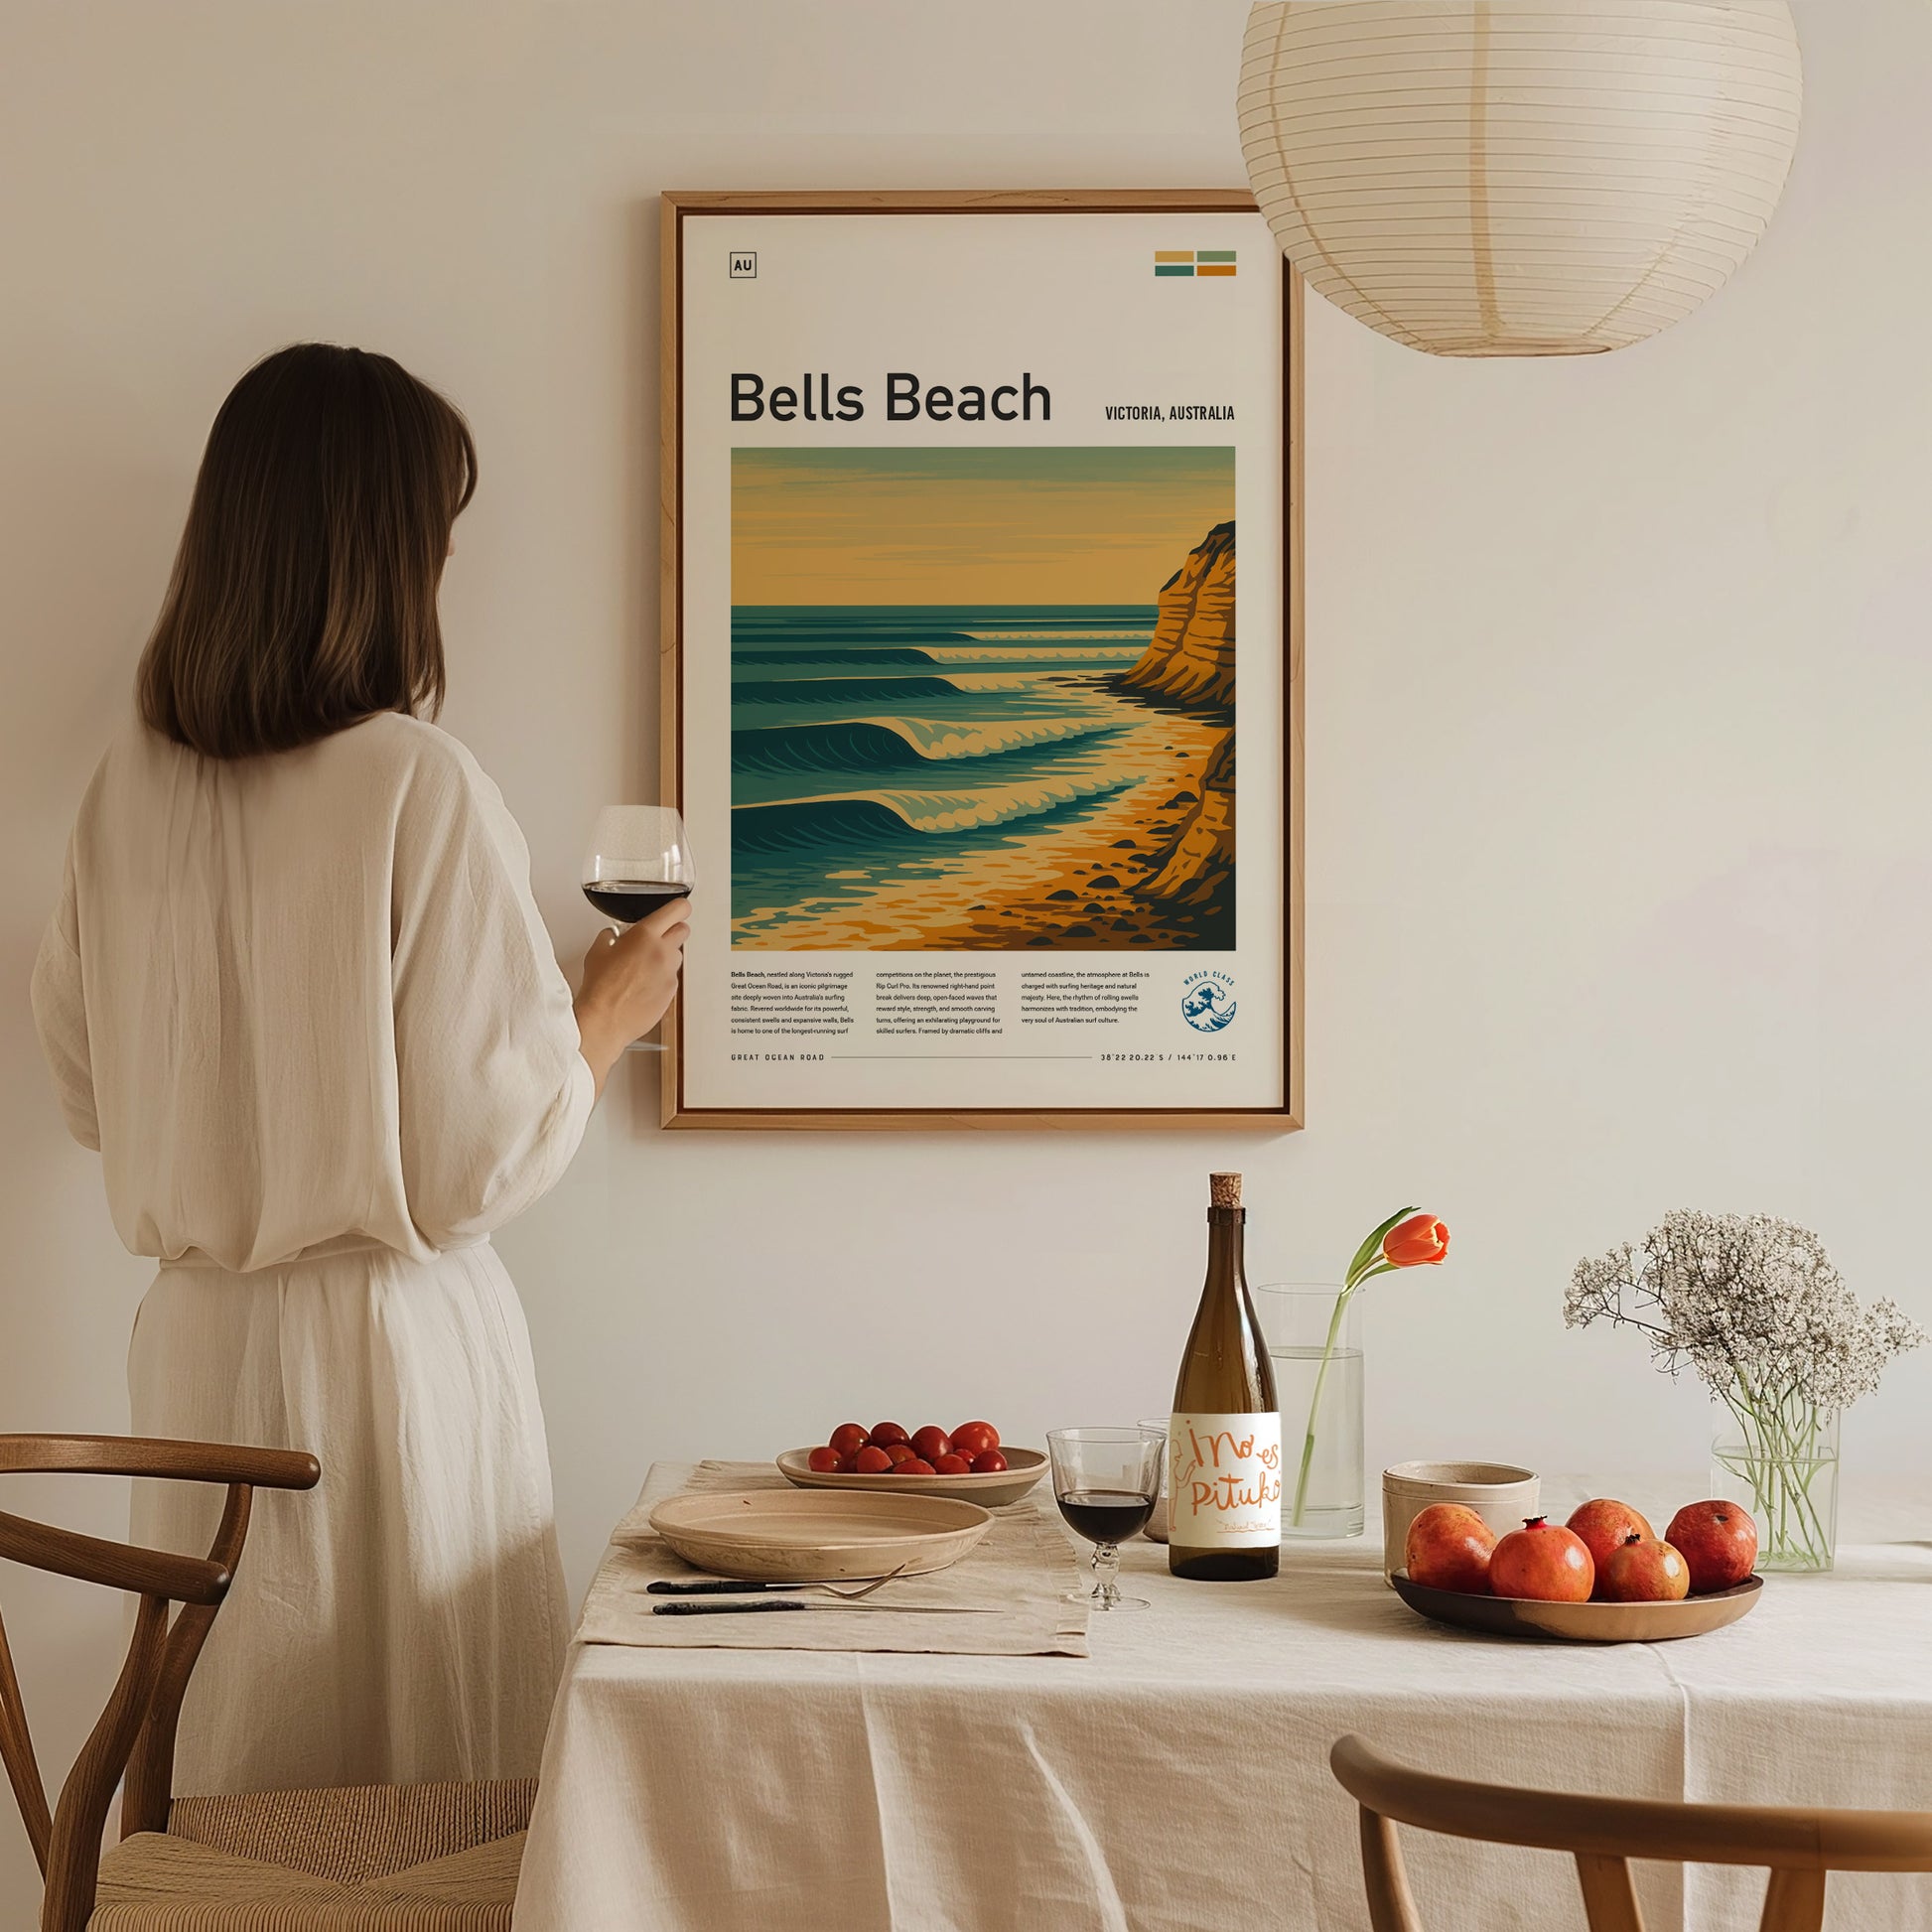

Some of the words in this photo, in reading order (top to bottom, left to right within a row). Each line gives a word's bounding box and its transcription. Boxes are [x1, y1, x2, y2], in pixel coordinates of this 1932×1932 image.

[734, 259, 752, 271] AU
[731, 372, 864, 422] Bells
[887, 372, 1050, 421] Beach
[1105, 406, 1166, 423] VICTORIA,
[1169, 405, 1235, 420] AUSTRALIA
[788, 971, 805, 980] along
[1183, 971, 1208, 985] WORLD
[1212, 971, 1235, 987] CLASS
[876, 982, 886, 991] Rip
[743, 994, 762, 1003] deeply
[824, 994, 845, 1003] surfing
[1021, 994, 1045, 1003] majesty.
[1072, 994, 1094, 1003] rhythm
[1101, 994, 1120, 1003] rolling
[897, 1005, 912, 1014] style,
[912, 1005, 938, 1014] strength,
[1095, 1005, 1128, 1014] embodying
